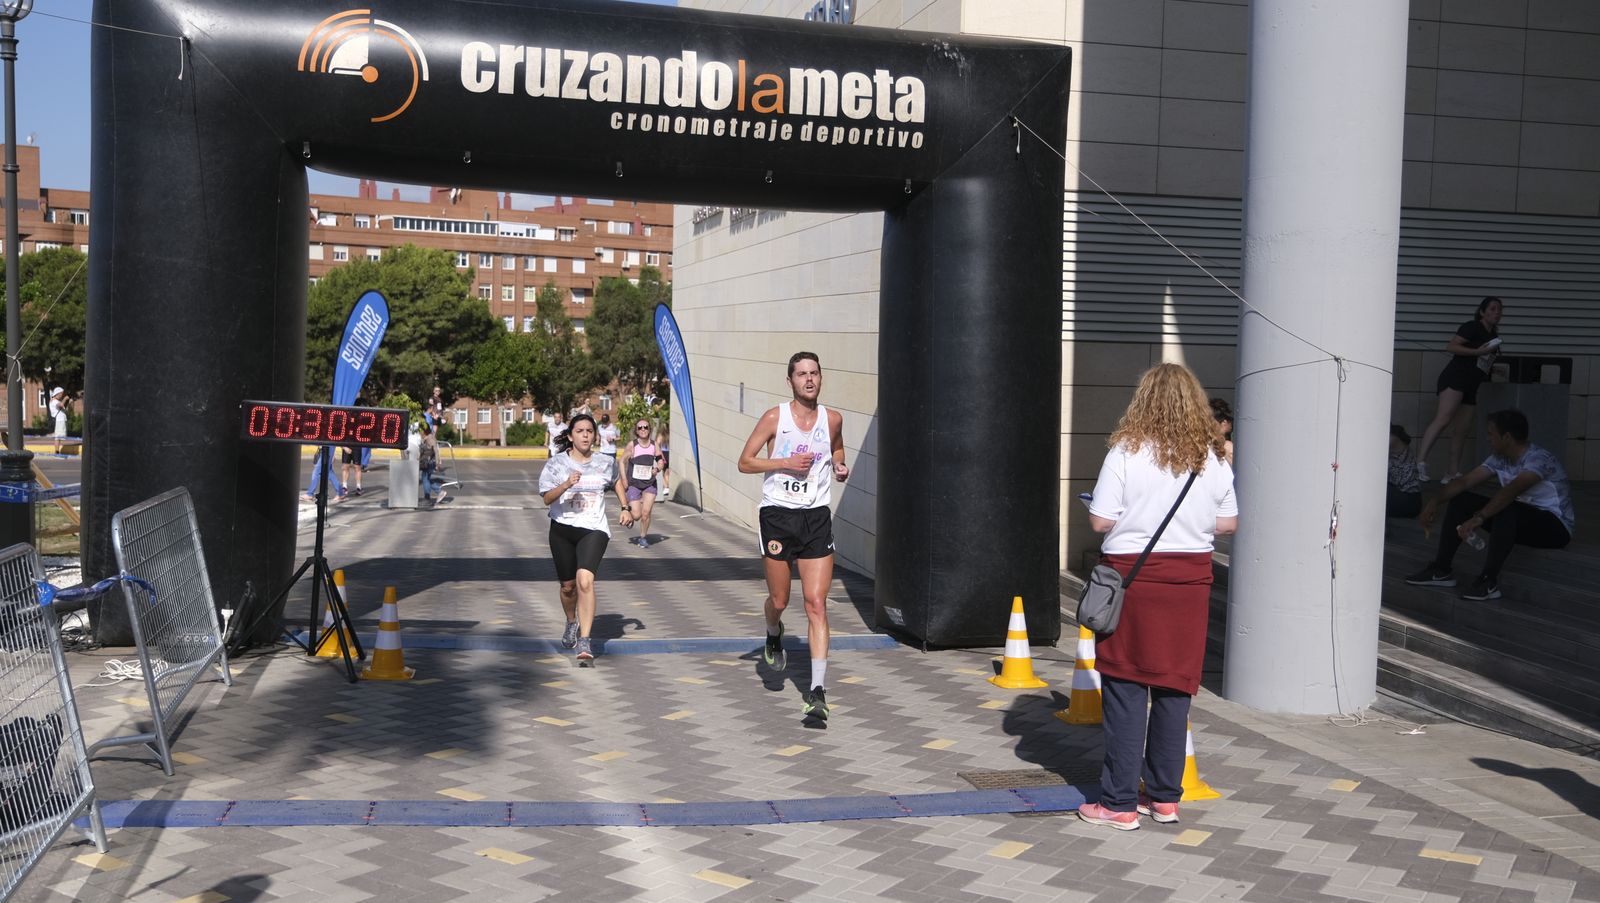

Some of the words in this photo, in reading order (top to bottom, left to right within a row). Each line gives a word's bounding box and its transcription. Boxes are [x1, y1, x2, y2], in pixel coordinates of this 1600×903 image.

[610, 111, 793, 142] cronometraje
[800, 121, 925, 150] deportivo
[796, 444, 808, 453] GO
[782, 480, 808, 493] 161
